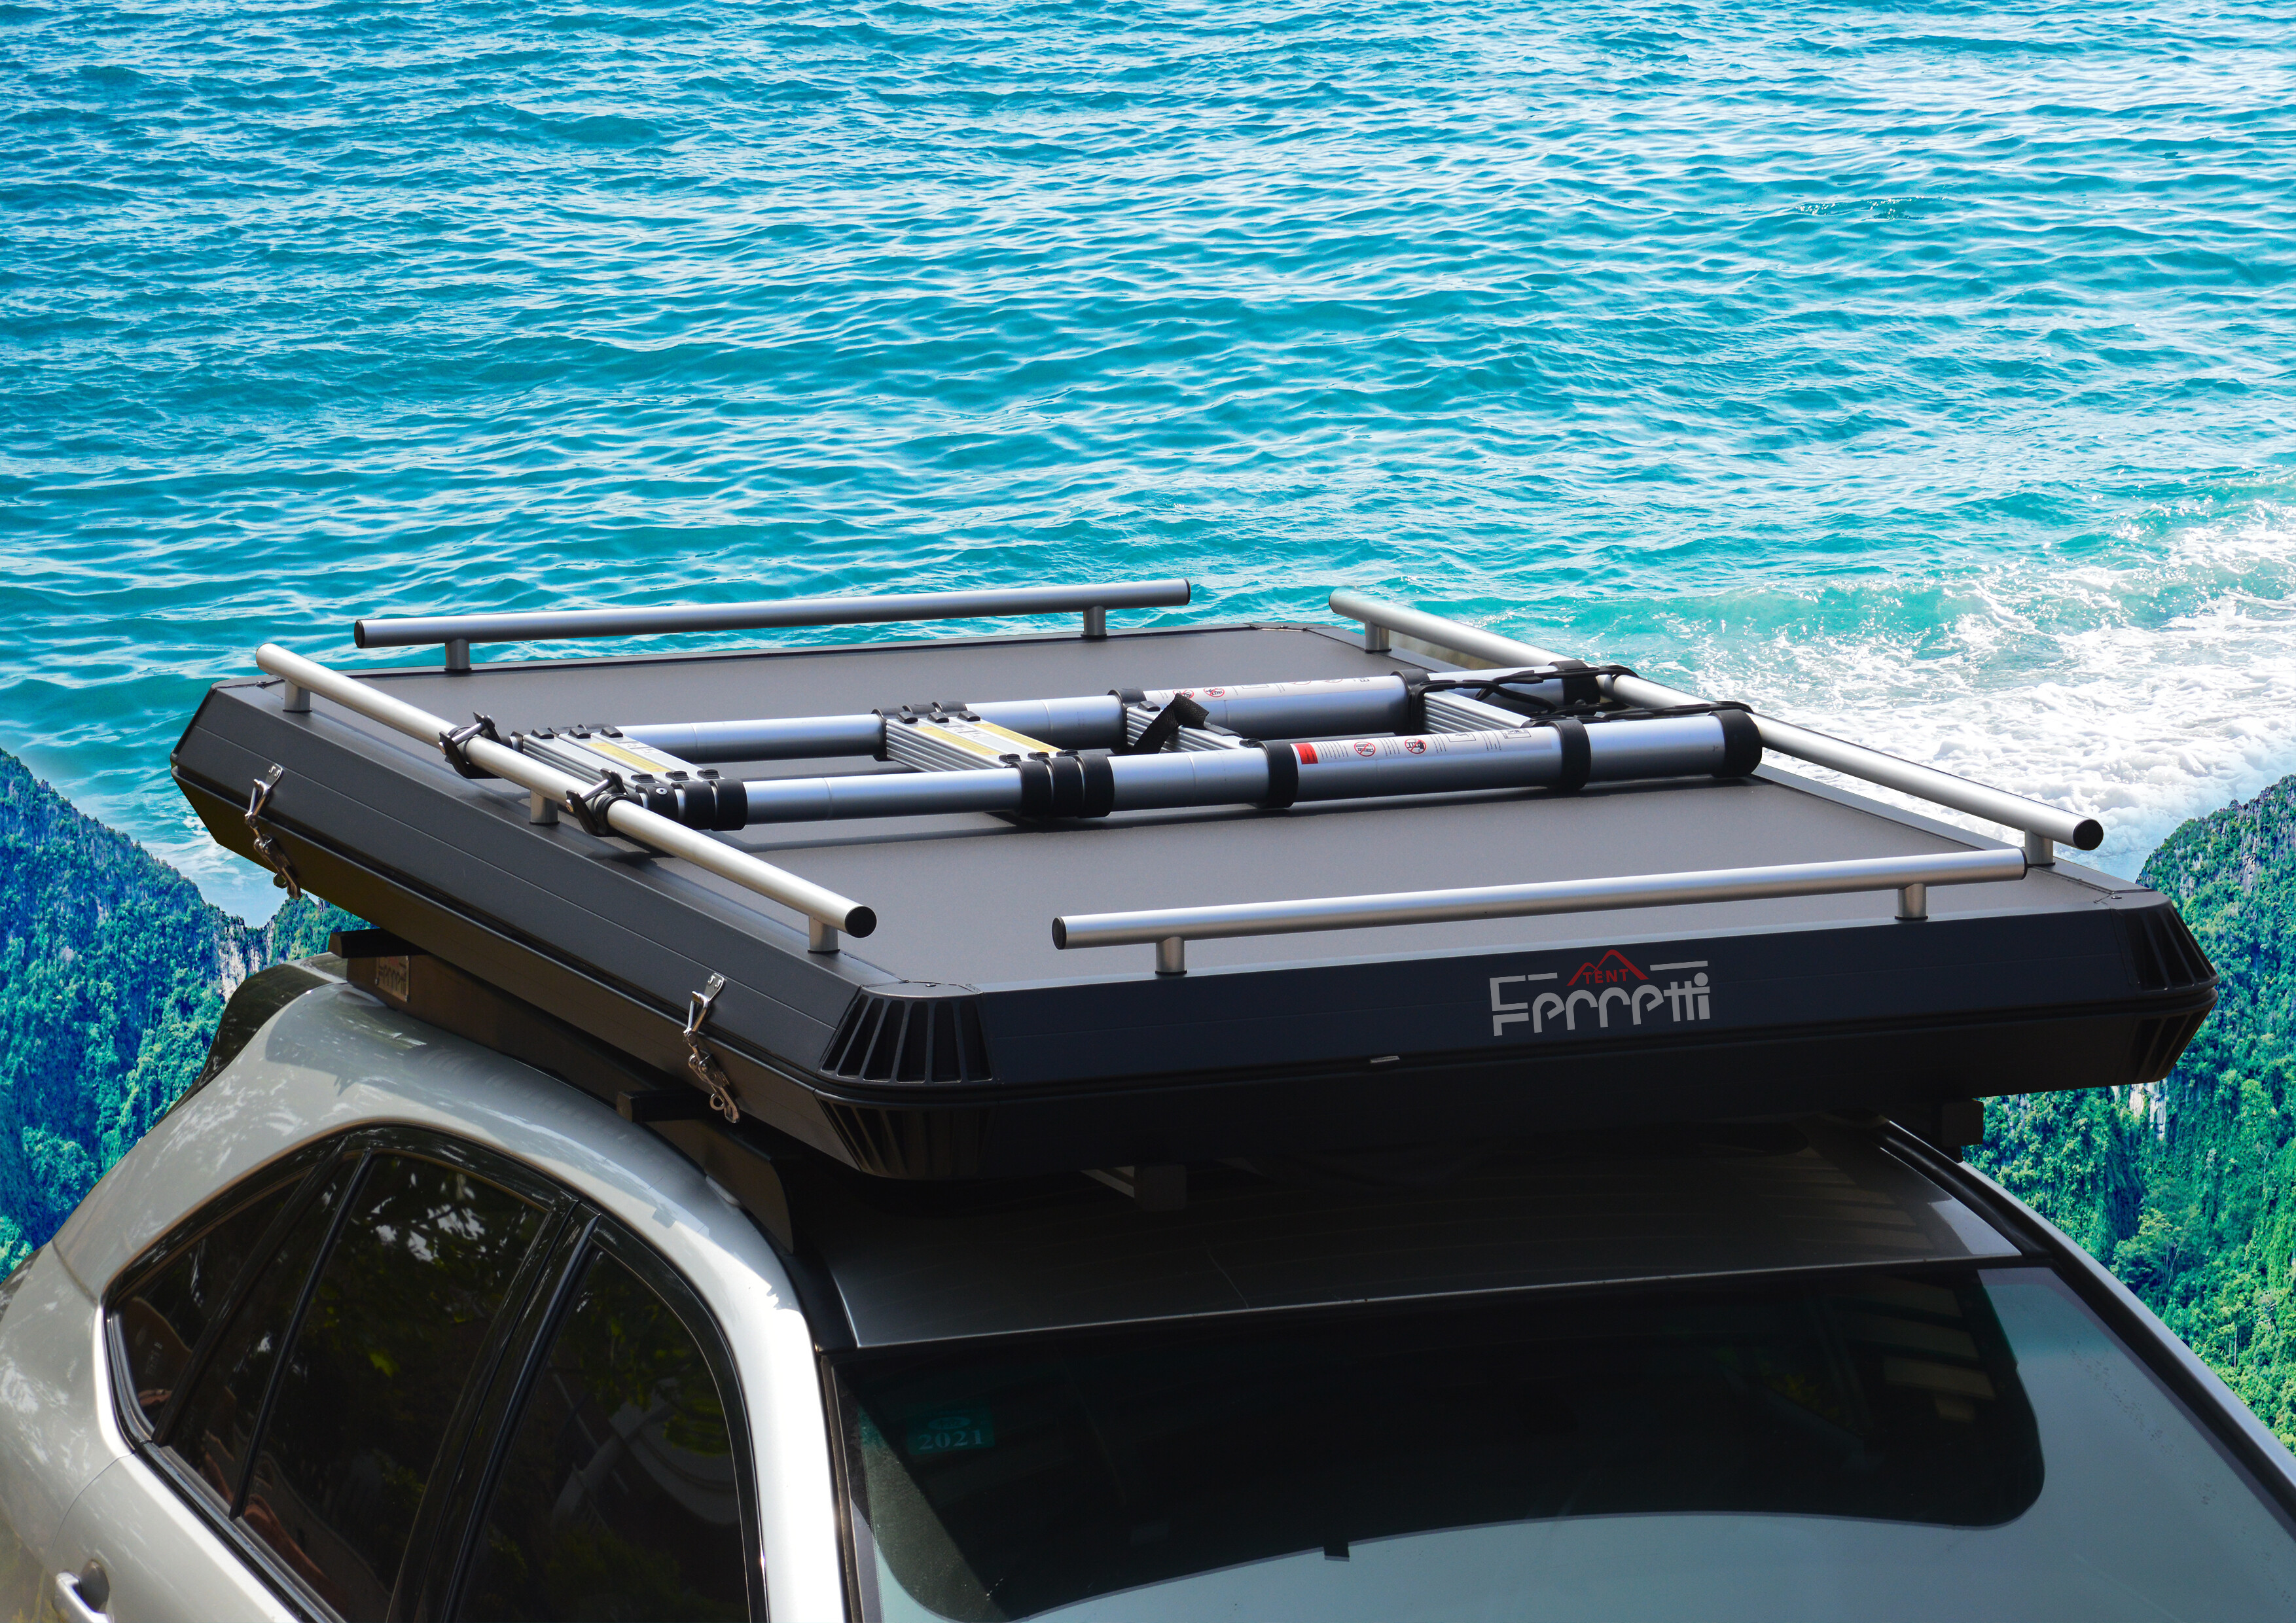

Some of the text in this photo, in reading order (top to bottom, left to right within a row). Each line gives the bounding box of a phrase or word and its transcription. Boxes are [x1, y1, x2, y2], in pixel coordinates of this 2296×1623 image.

[1583, 969, 1628, 984] TENT
[1489, 961, 1710, 1036] Ferretti
[918, 1429, 984, 1451] 2021
